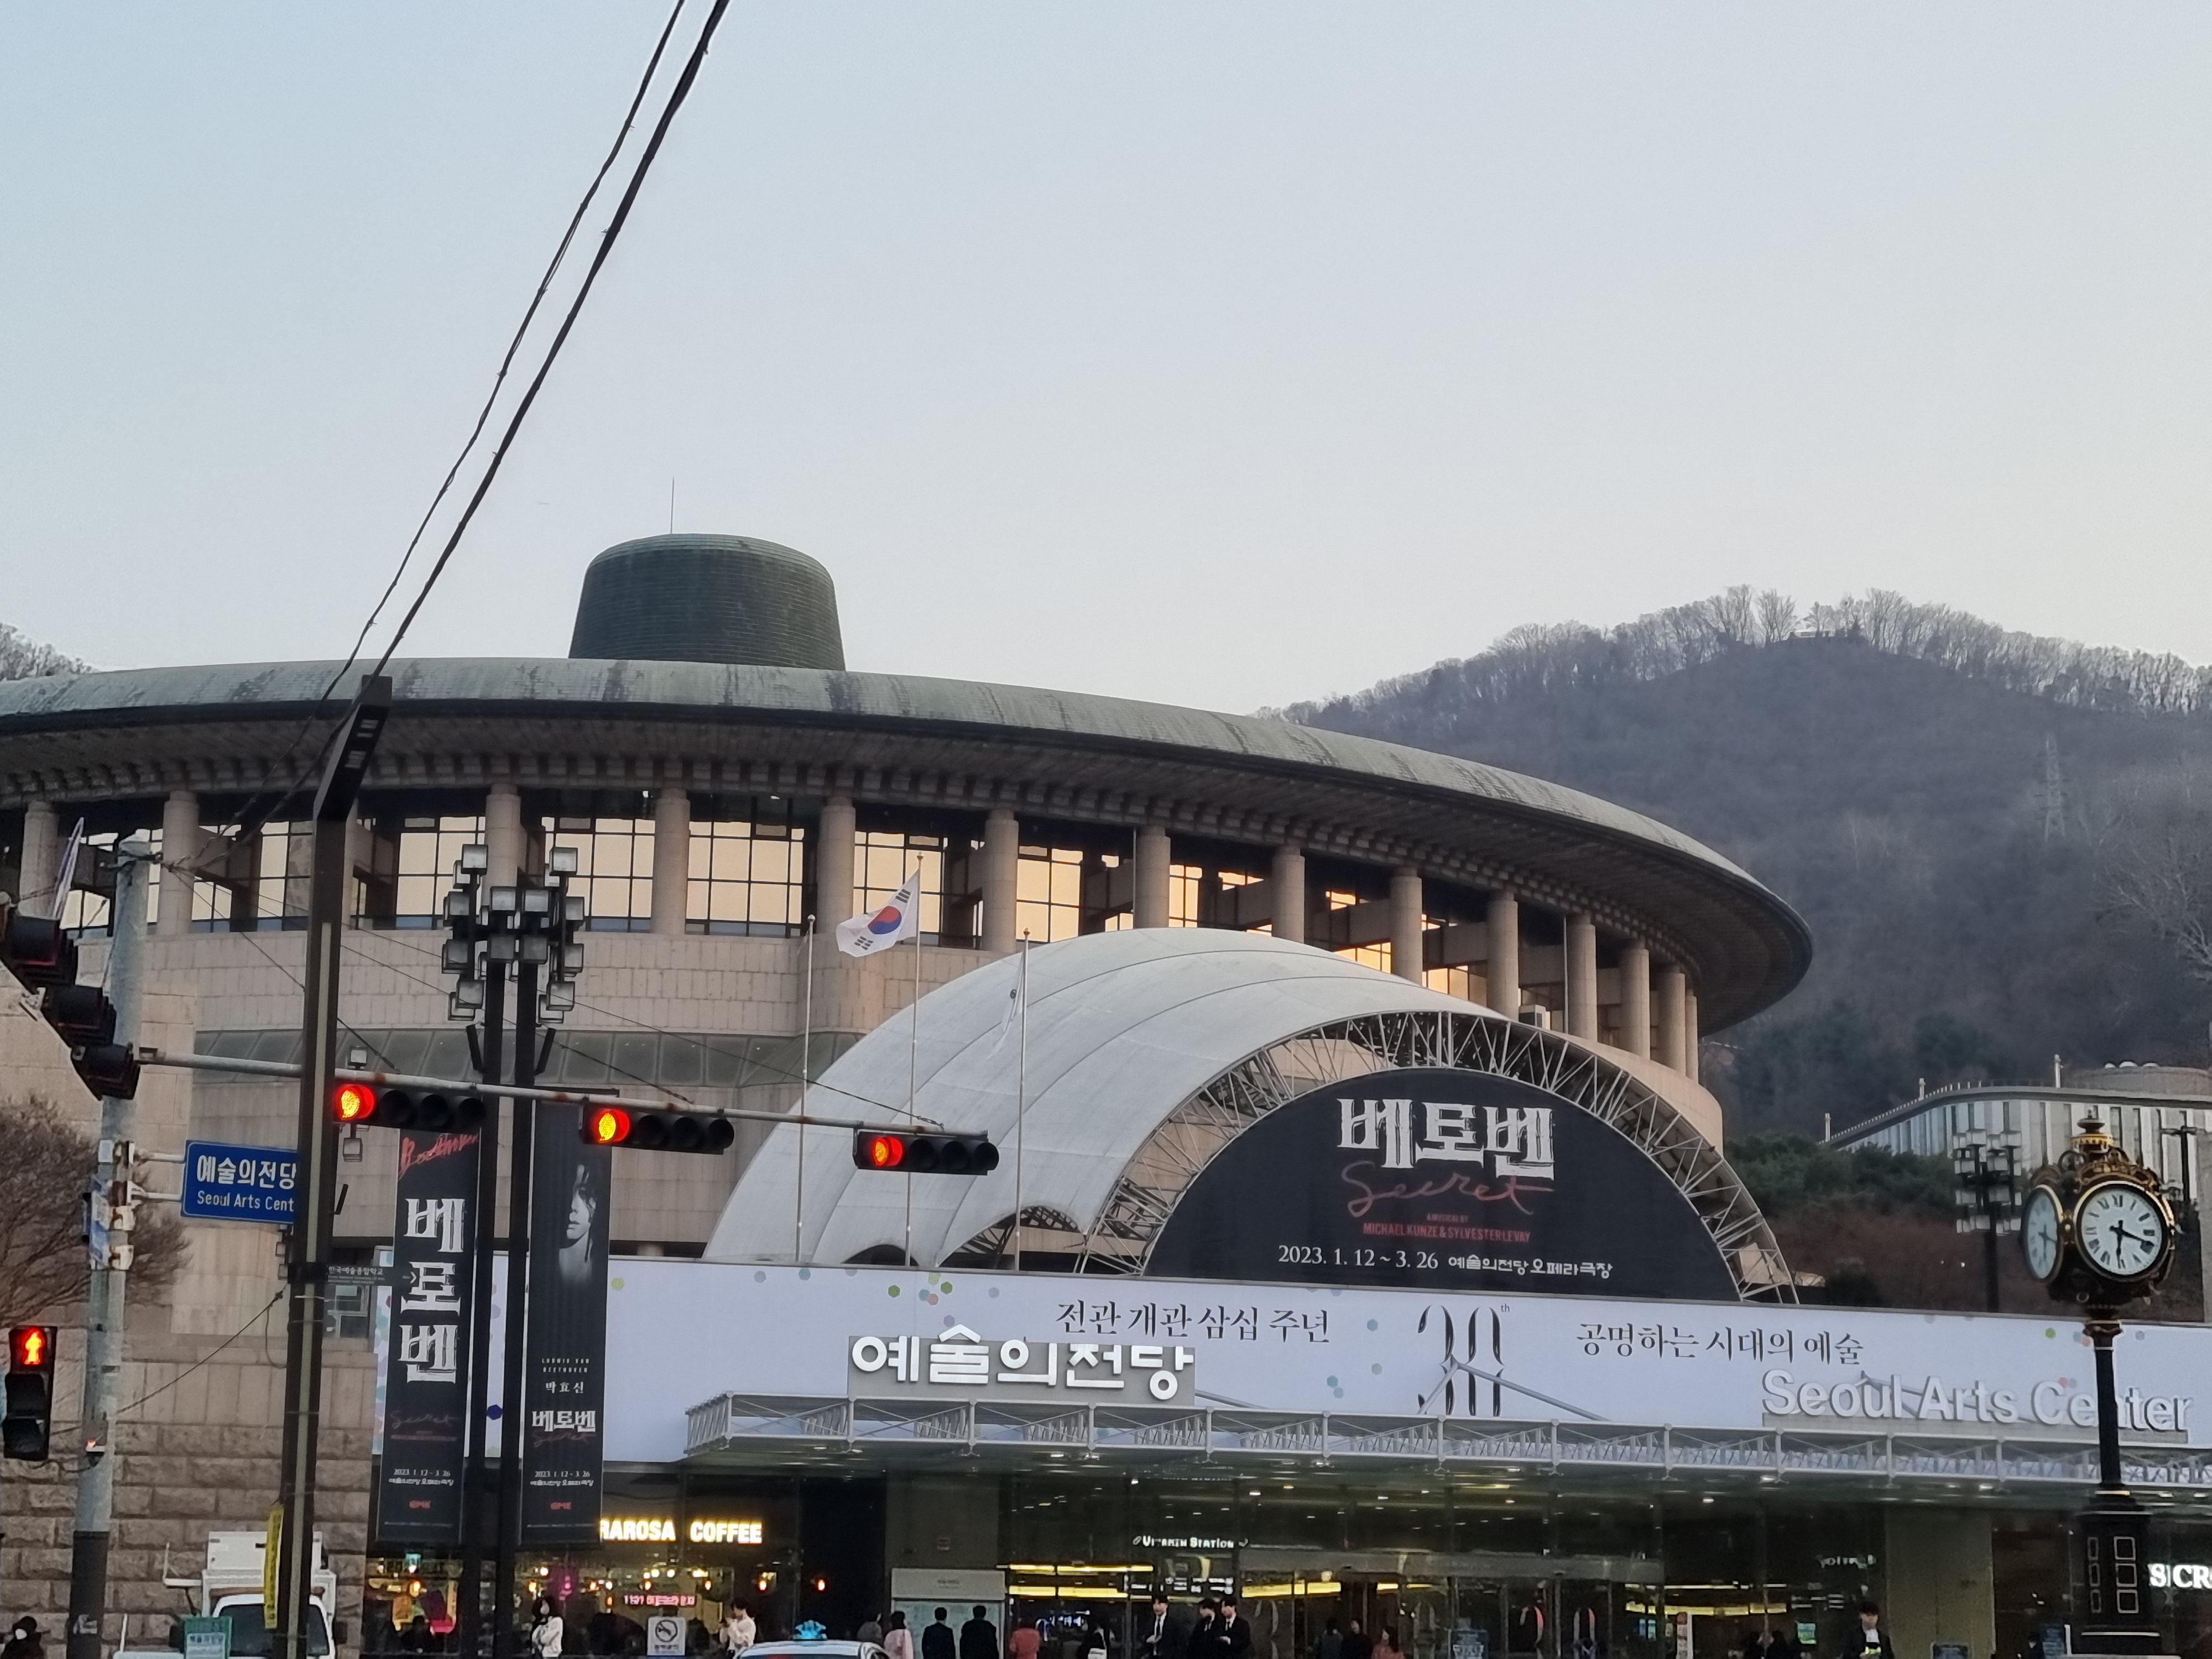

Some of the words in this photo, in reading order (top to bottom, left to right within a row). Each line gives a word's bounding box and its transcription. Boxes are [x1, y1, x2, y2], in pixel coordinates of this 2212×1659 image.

[1337, 1098, 1554, 1180] 베토벤
[197, 1155, 296, 1190] 예술의전당
[1341, 1161, 1554, 1217] Secret
[197, 1190, 230, 1207] Seoul
[233, 1193, 260, 1208] Arts
[265, 1197, 294, 1212] Cent
[1364, 1223, 1405, 1236] MICHAEL
[1407, 1224, 1438, 1238] KUNZE
[1439, 1225, 1446, 1238] &
[1448, 1226, 1501, 1241] SYLVESTER
[1279, 1245, 1327, 1264] 2023.
[1334, 1248, 1348, 1265] 1.
[1355, 1249, 1375, 1266] 12
[1396, 1250, 1411, 1268] 3.
[1416, 1251, 1438, 1269] 26
[1448, 1254, 1529, 1275] 예술의전당
[1530, 1258, 1613, 1279] 오페라극장
[397, 1198, 468, 1384] 베토벤
[1056, 1300, 1121, 1334] 전관
[1128, 1302, 1192, 1338] 개관
[1198, 1305, 1258, 1341] 삼십
[1269, 1310, 1329, 1343] 주년
[852, 1324, 1194, 1400] 예술의전당
[1577, 1323, 1699, 1358] 공명하는
[1706, 1327, 1793, 1364] 시대의
[1804, 1331, 1864, 1365] 예술
[531, 1410, 596, 1433] 베토벤
[1762, 1369, 1902, 1418] Seoul
[1917, 1375, 2018, 1423] Arts
[2032, 1381, 2193, 1432] Ceter
[600, 1520, 676, 1541] RAROSA
[691, 1521, 762, 1543] COFFEE
